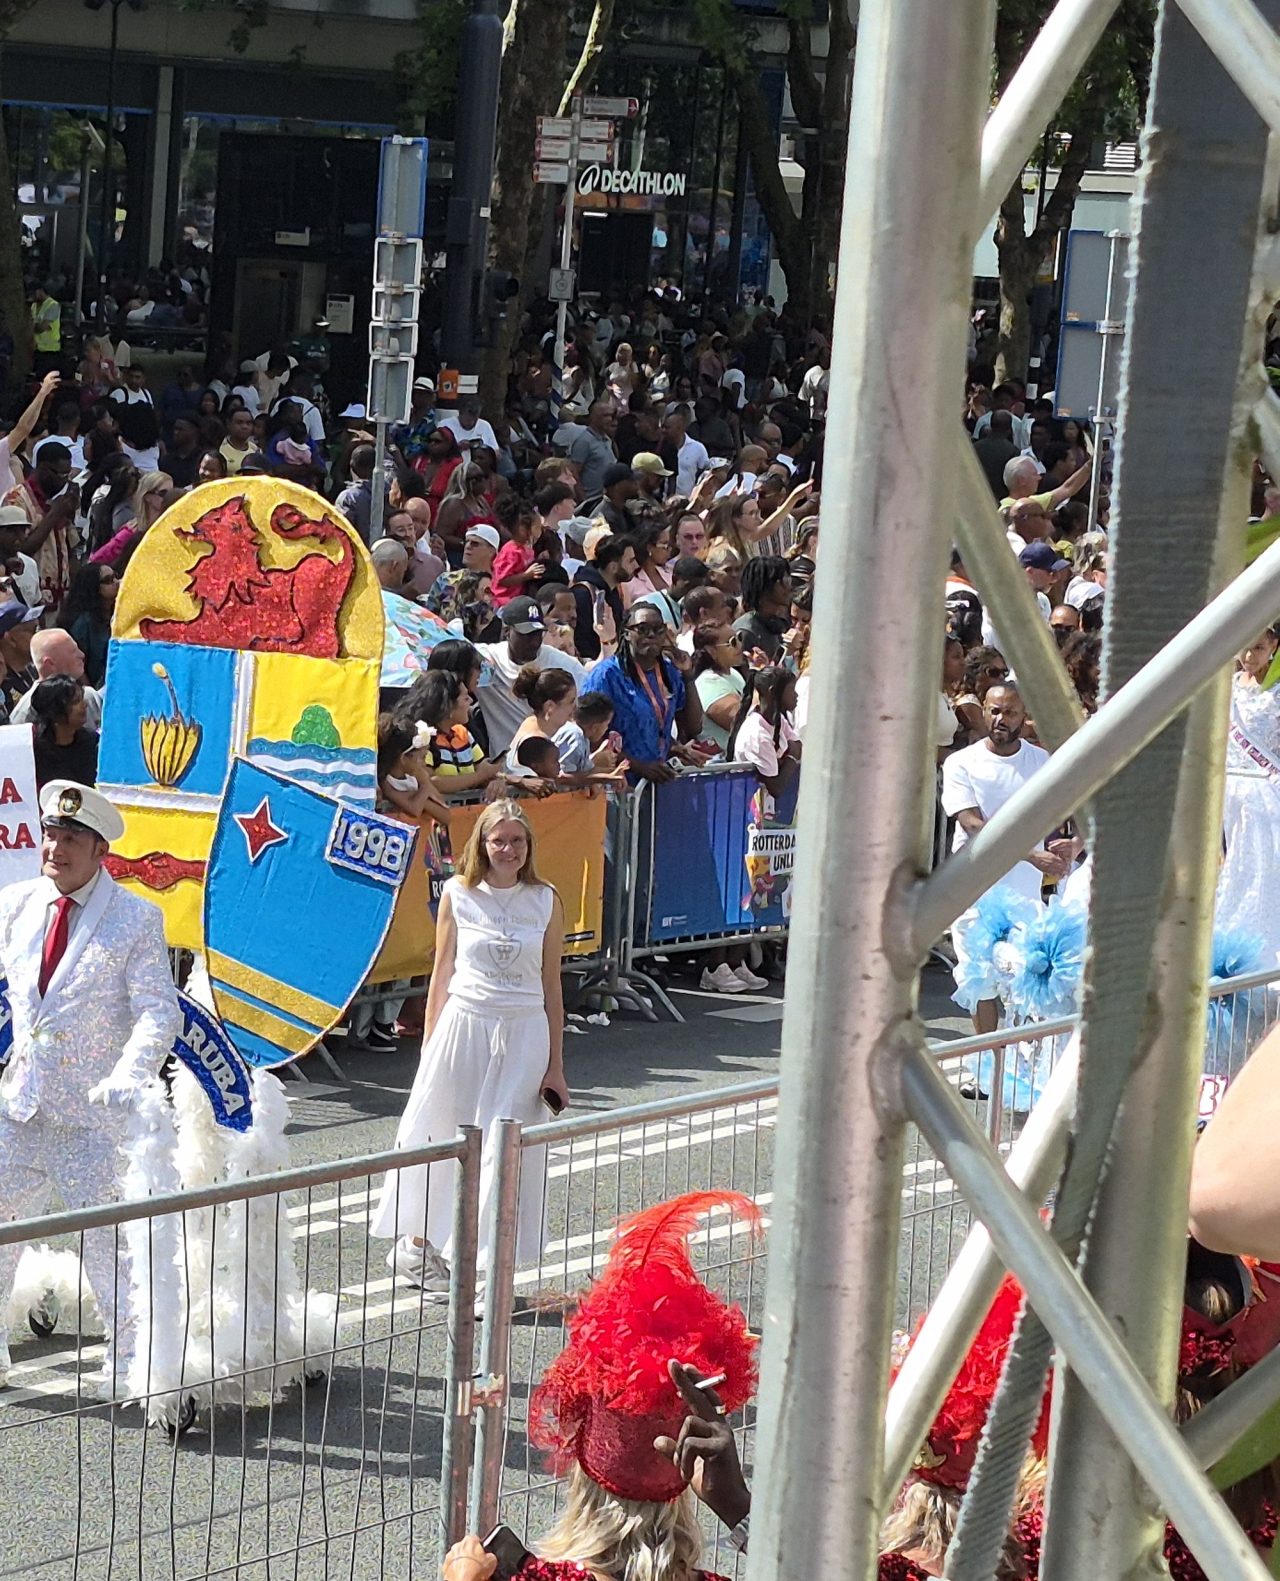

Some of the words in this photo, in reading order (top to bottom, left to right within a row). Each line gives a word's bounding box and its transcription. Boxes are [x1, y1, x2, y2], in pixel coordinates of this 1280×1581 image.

[601, 168, 687, 196] DECATHLON
[333, 817, 405, 871] 1998
[752, 833, 796, 851] ROTTERDA
[773, 852, 794, 871] UNLI
